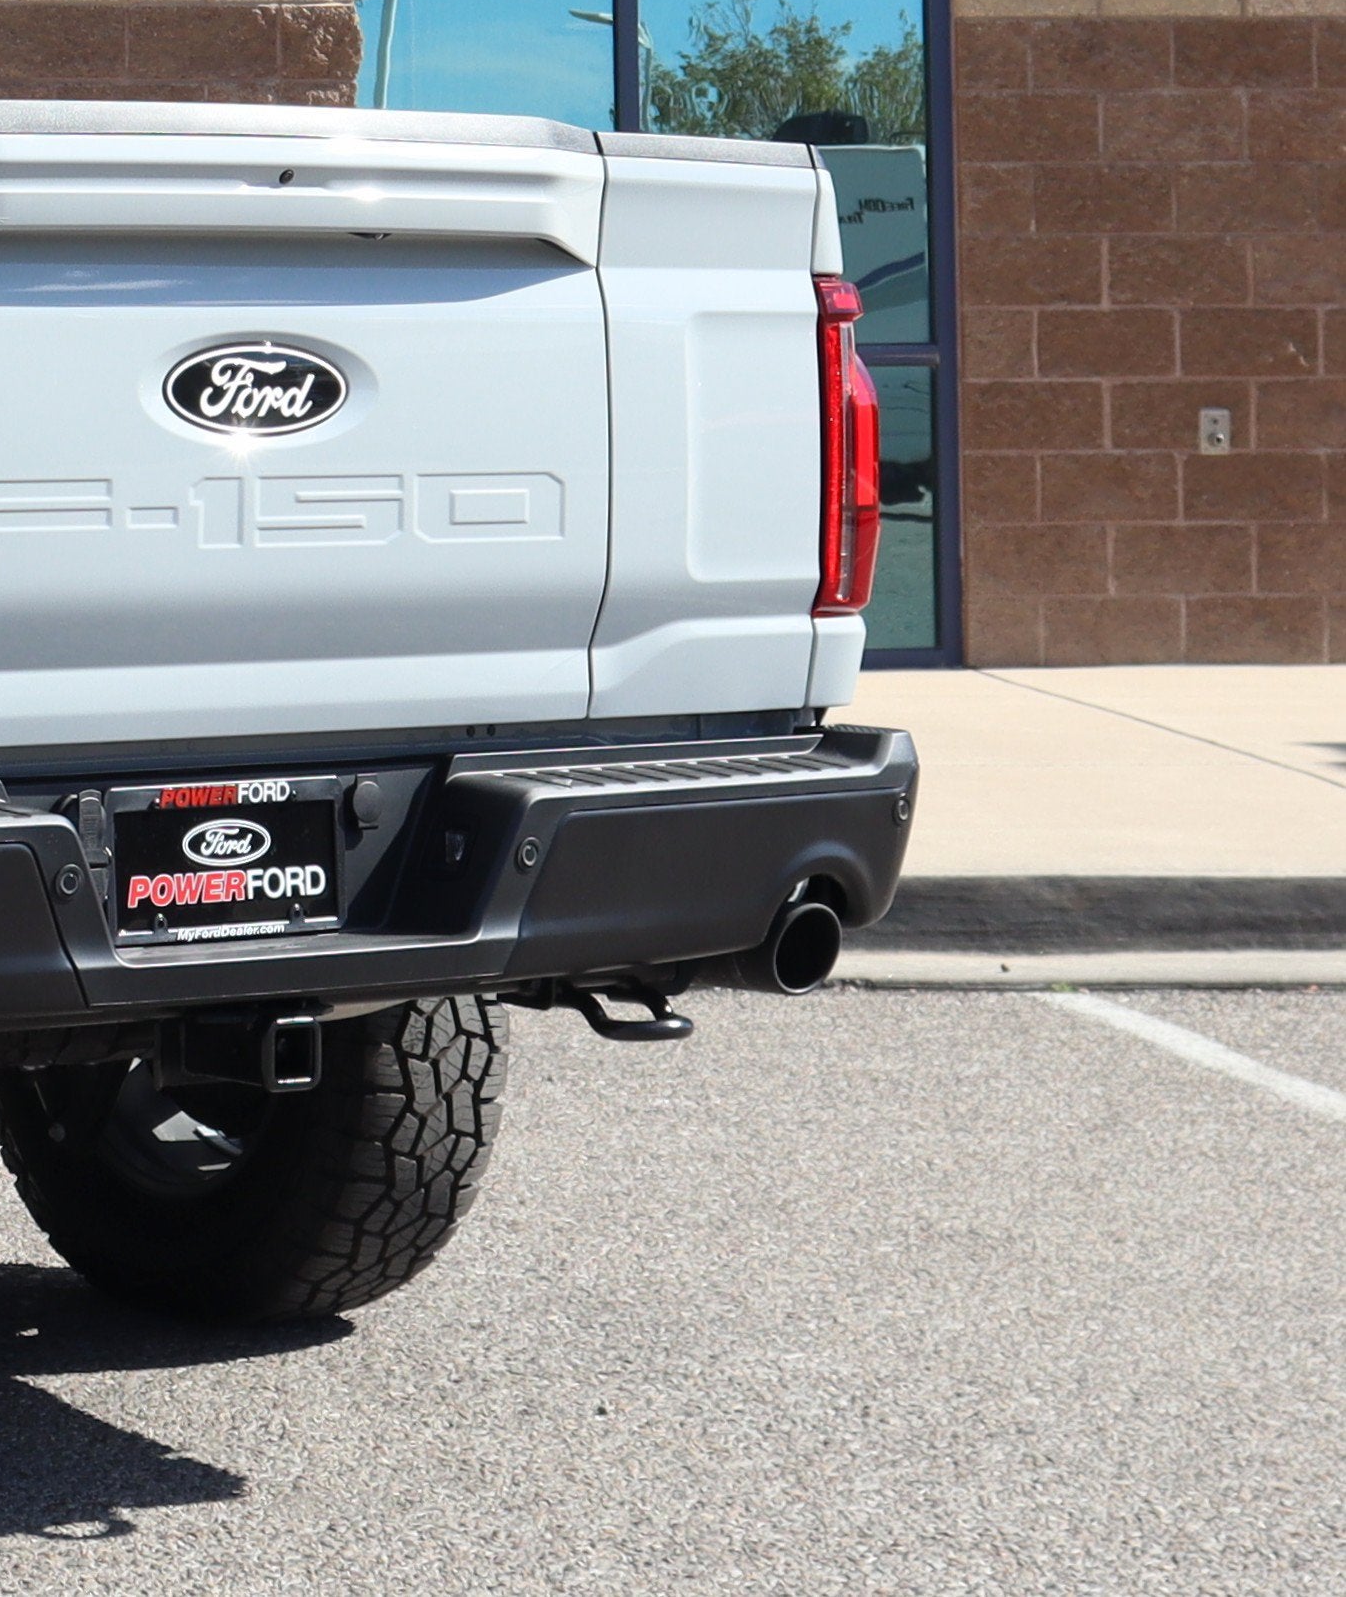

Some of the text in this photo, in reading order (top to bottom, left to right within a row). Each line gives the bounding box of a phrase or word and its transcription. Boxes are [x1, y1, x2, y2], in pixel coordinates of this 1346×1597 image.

[200, 357, 315, 419] Ford
[160, 781, 290, 809] POWERFORD
[200, 828, 253, 856] Ford
[127, 865, 326, 909] POWERFORD
[177, 923, 285, 942] MyFordDealer.com
